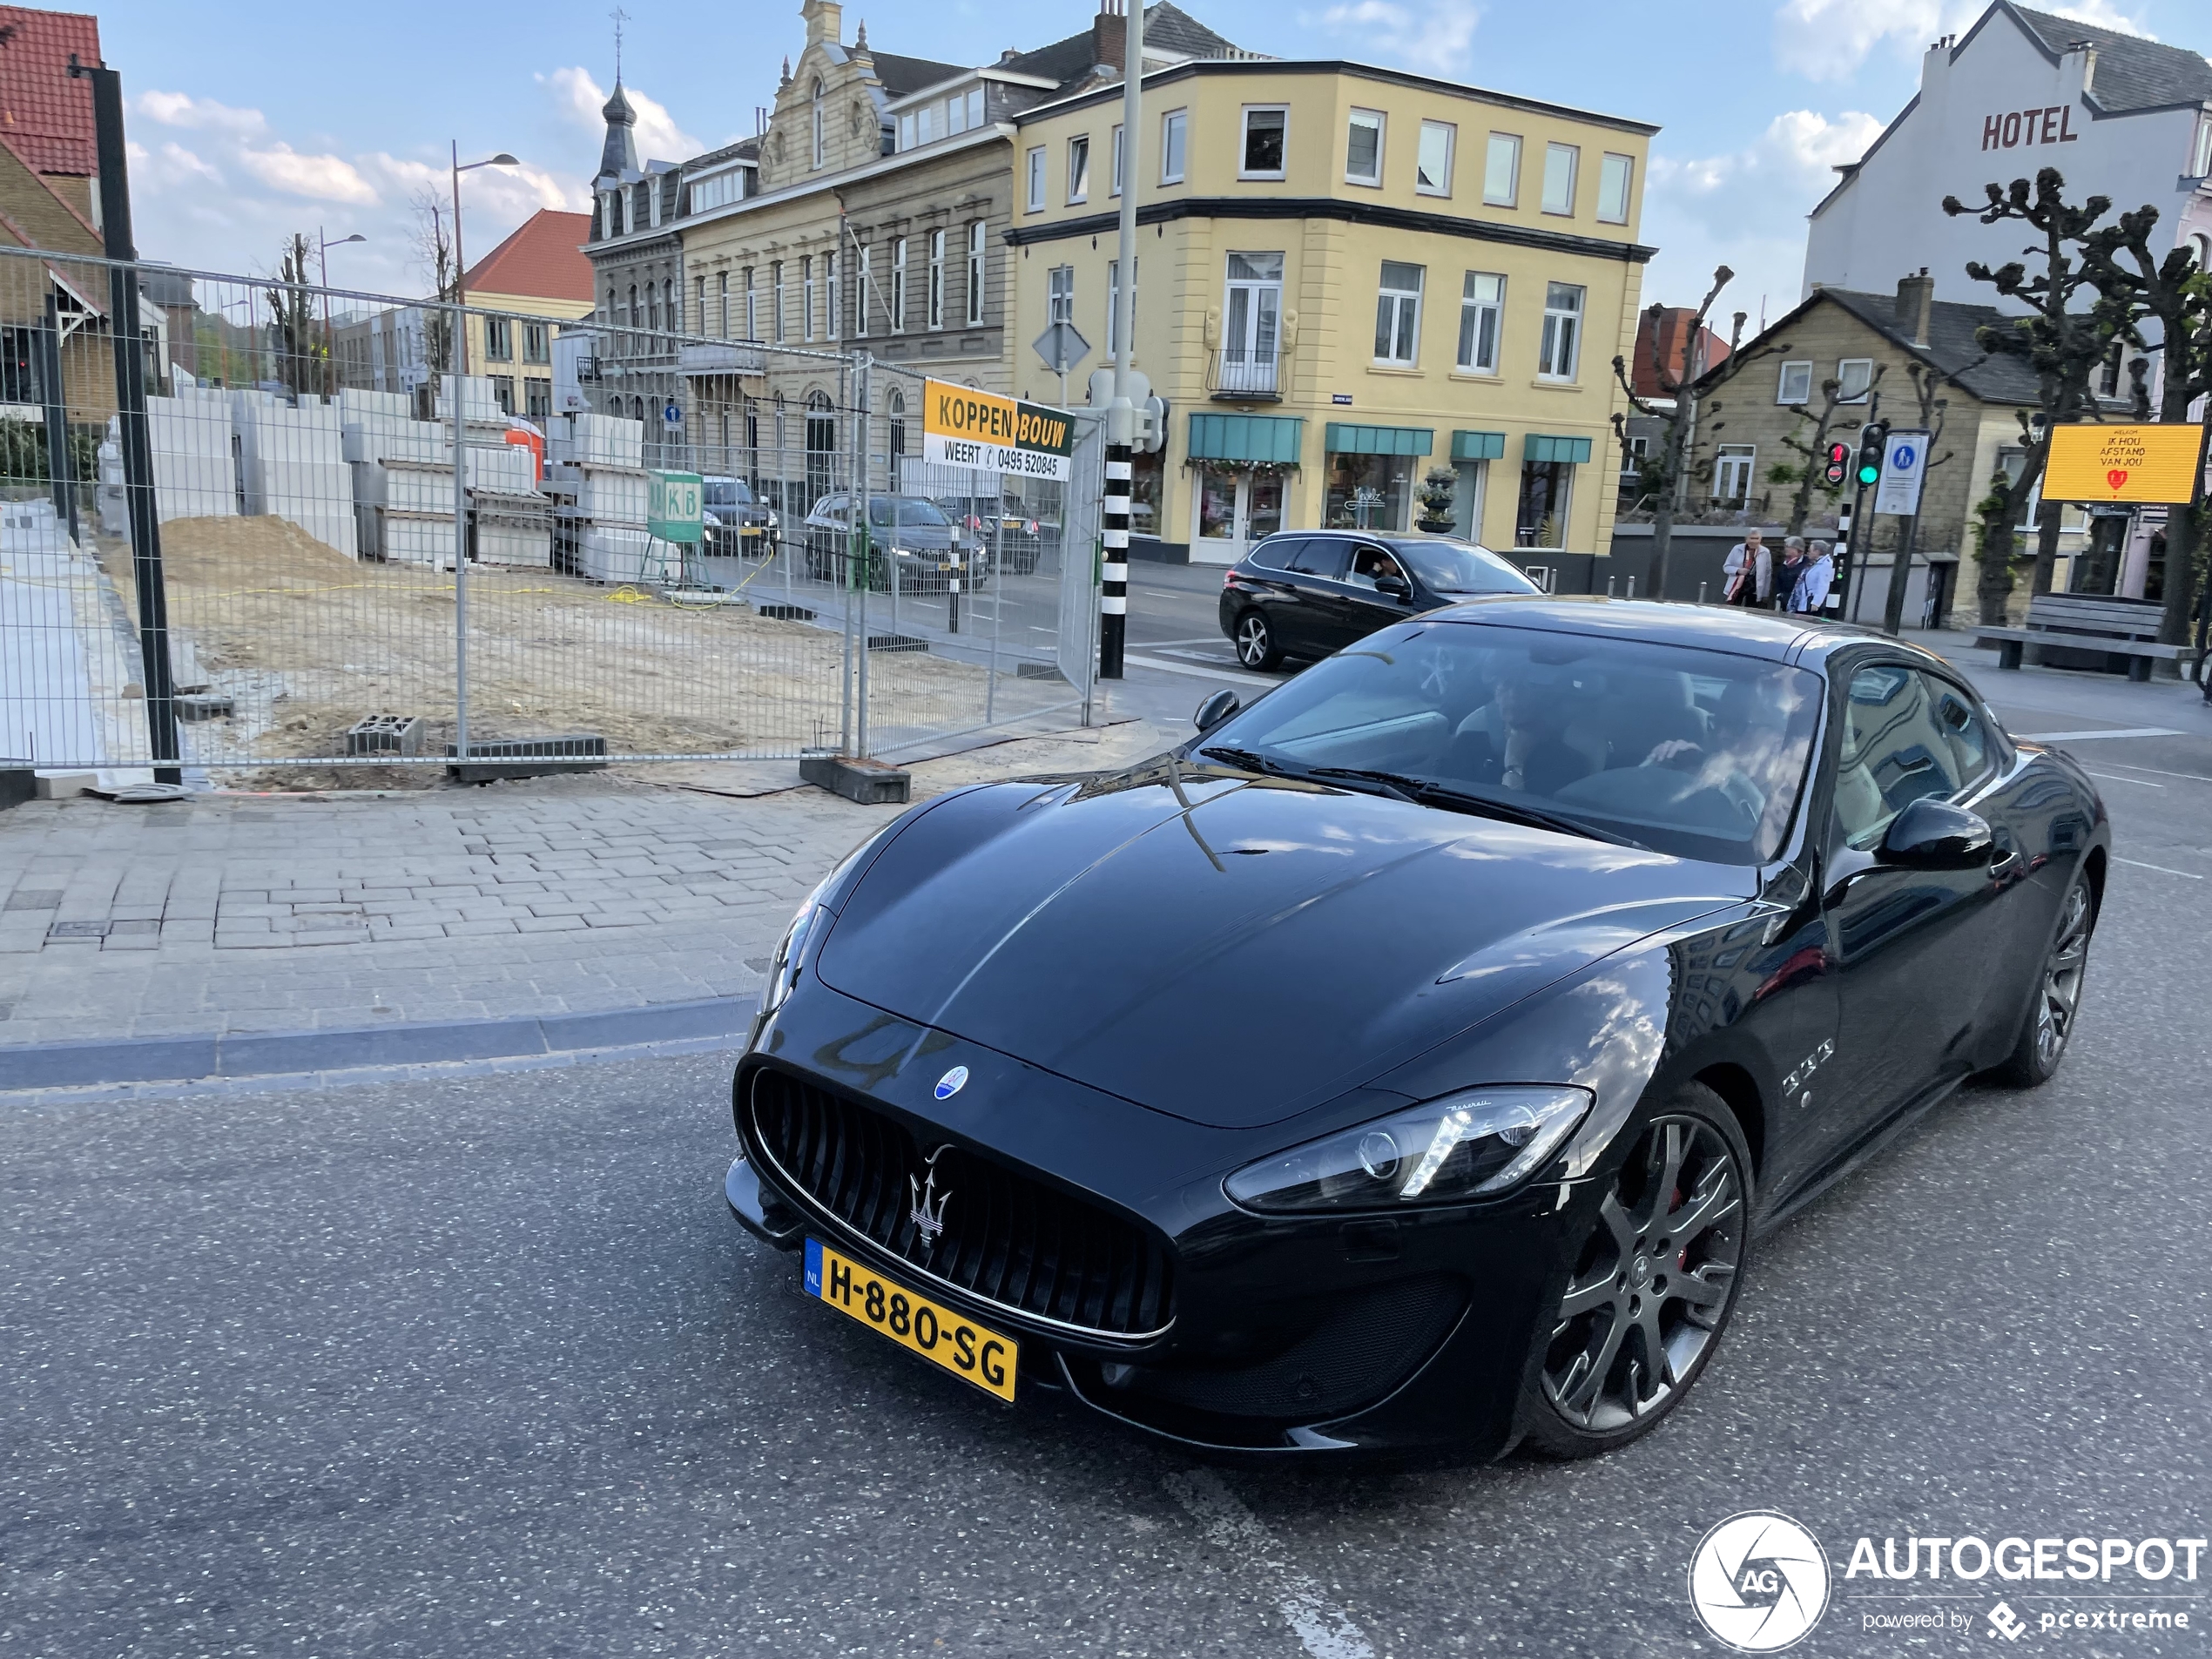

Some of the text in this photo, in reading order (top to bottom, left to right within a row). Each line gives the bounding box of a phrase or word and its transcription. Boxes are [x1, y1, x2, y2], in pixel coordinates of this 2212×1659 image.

[1981, 105, 2078, 152] HOTEL
[939, 395, 1067, 448] KOPPEN BOUW
[2107, 437, 2141, 446] IK HOU
[945, 441, 1058, 476] WEERT 0495 520845
[2100, 447, 2146, 456] AFSTAND
[2101, 457, 2142, 467] VAN JOU
[1446, 1099, 1492, 1112] Maserati
[806, 1269, 820, 1288] NL
[830, 1258, 1005, 1386] H-880-SG
